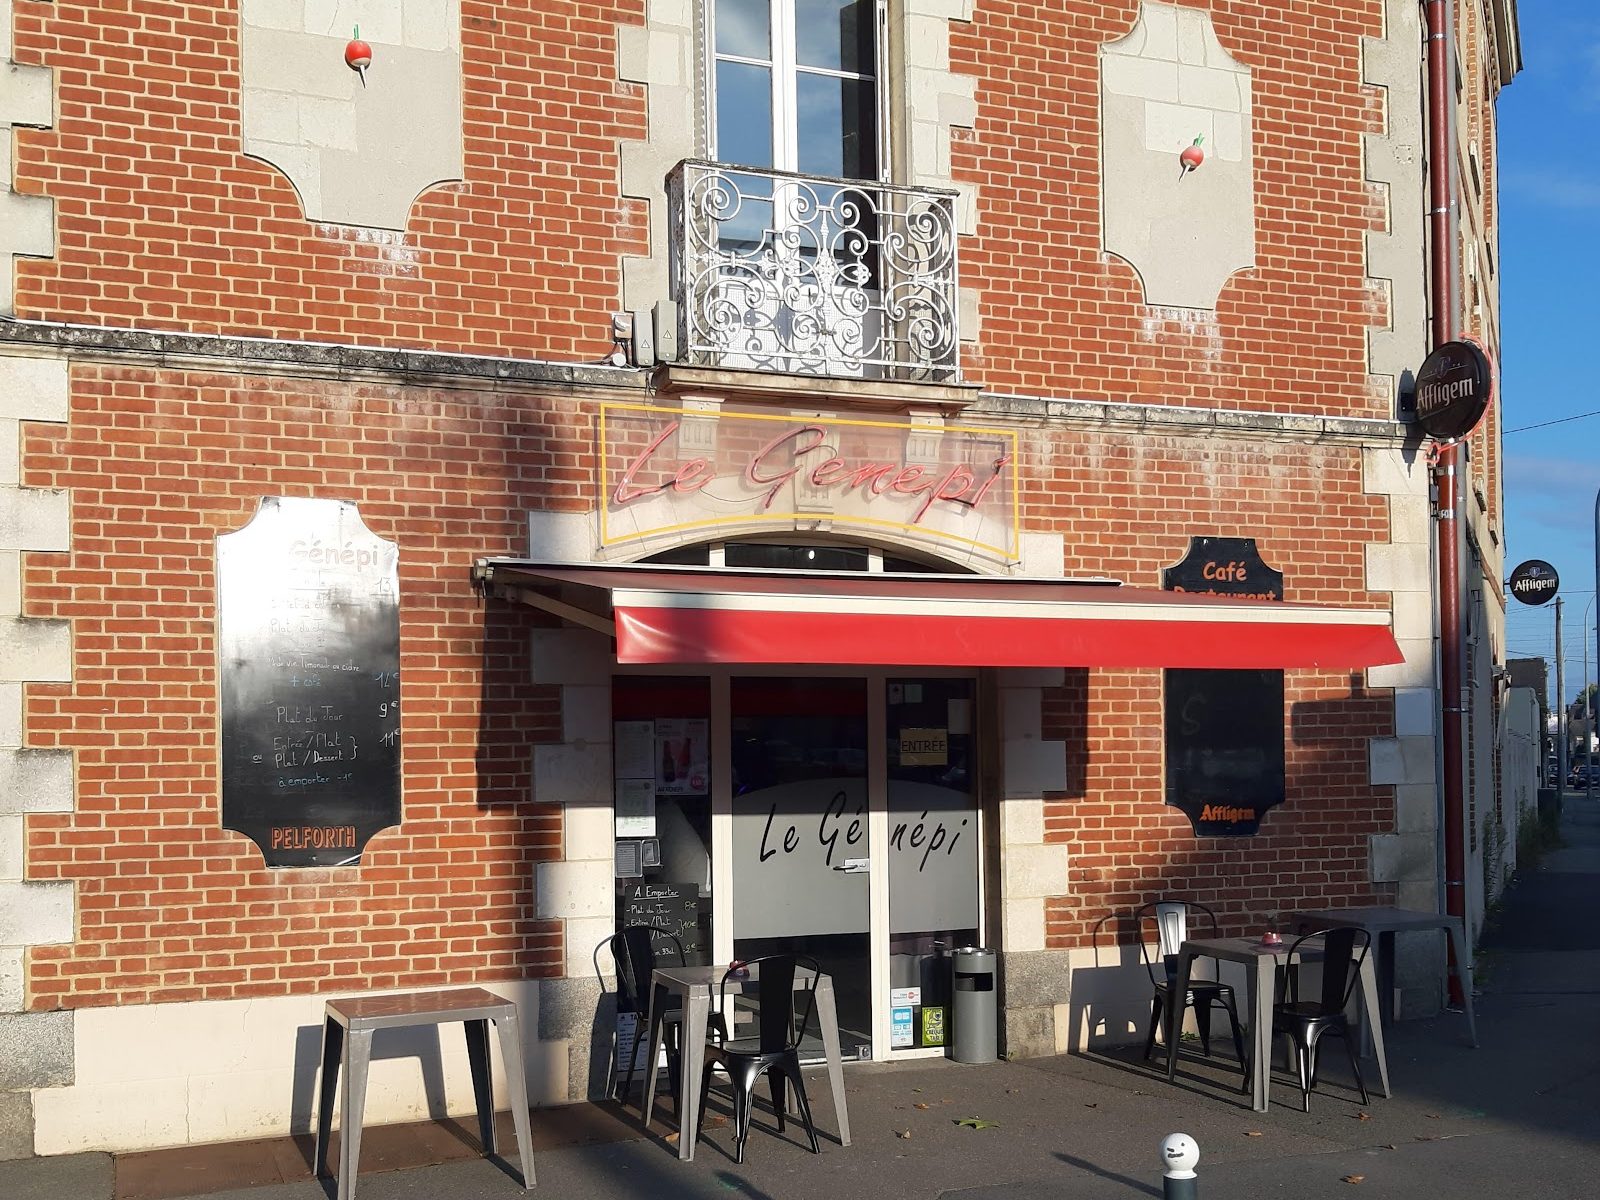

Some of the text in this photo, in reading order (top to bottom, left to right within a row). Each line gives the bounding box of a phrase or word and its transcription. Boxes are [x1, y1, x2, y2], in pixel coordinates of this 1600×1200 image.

[1416, 378, 1474, 411] Affligem
[613, 421, 715, 505] Le
[1203, 560, 1248, 582] Café
[1513, 578, 1557, 592] Affligem
[277, 706, 301, 723] Plat
[305, 706, 318, 723] du
[321, 706, 344, 721] Jour
[275, 752, 298, 769] Plat
[288, 772, 330, 786] emporter
[271, 825, 357, 850] PELFORTH
[760, 803, 800, 862] Le
[634, 886, 641, 898] A
